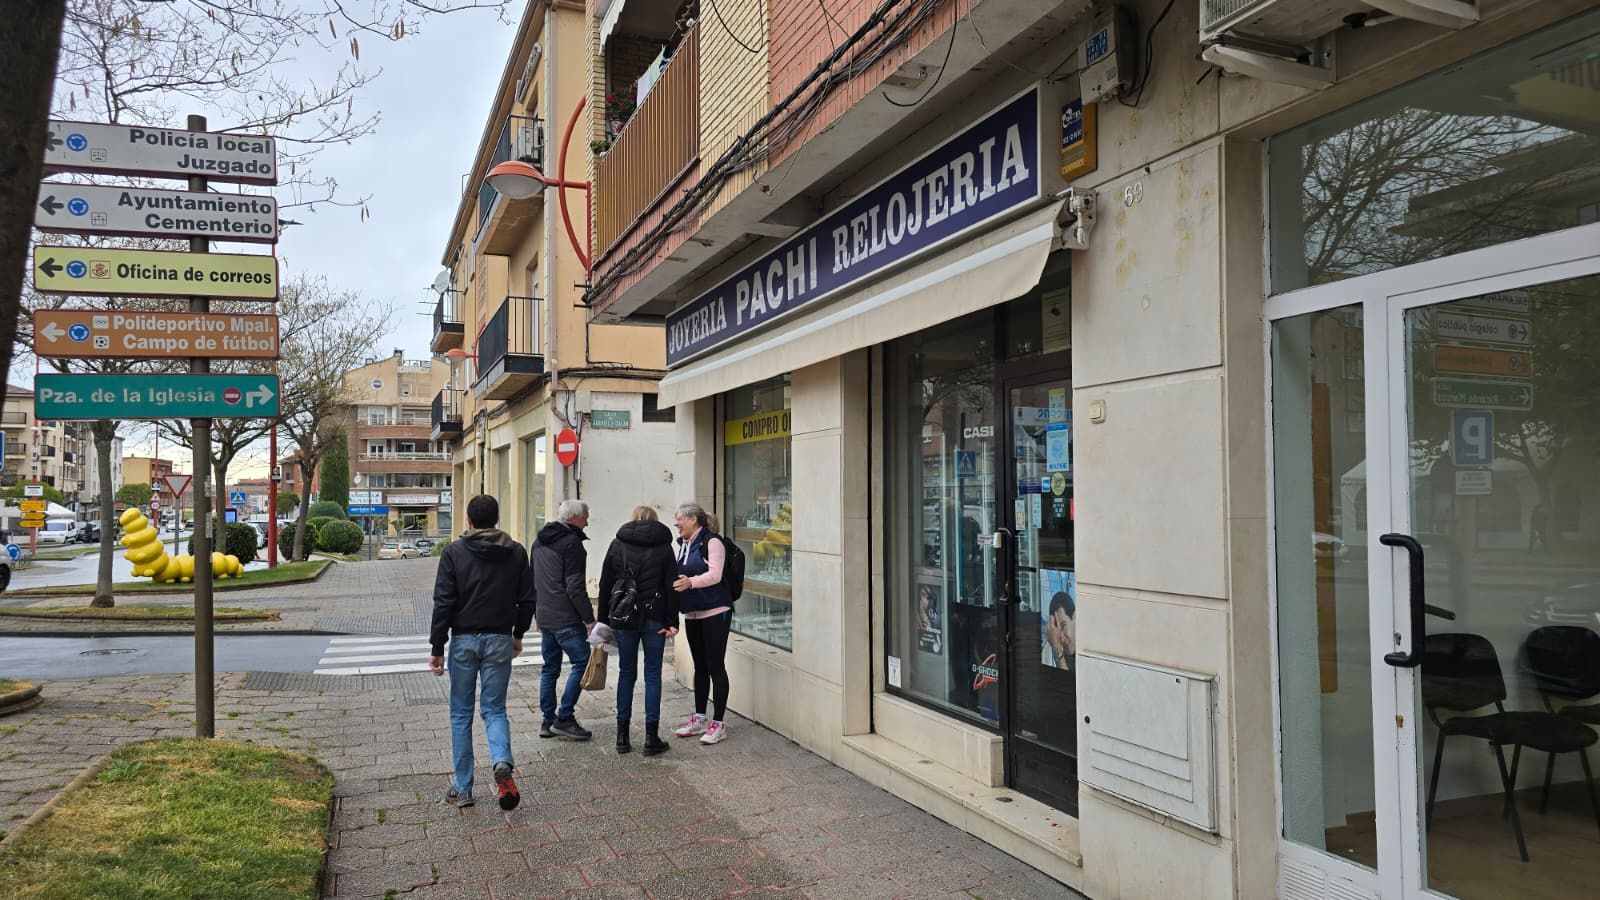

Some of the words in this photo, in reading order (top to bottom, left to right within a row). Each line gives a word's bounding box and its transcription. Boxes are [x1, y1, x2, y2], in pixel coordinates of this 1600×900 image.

[129, 128, 209, 150] Policía
[217, 136, 271, 154] local
[177, 153, 272, 175] Juzgado
[118, 191, 272, 215] Ayuntamiento
[1124, 182, 1144, 207] 69
[144, 213, 273, 235] Cementerio
[669, 296, 727, 355] JOYERIA
[736, 237, 818, 326] PACHI
[832, 123, 1030, 274] RELOJERIA
[116, 263, 178, 281] Oficina
[183, 266, 204, 282] de
[209, 269, 272, 285] correos
[113, 314, 226, 333] Polideportivo
[230, 317, 275, 337] Mpal.
[123, 333, 189, 353] Campo
[195, 335, 217, 350] de
[222, 334, 275, 351] fútbol
[40, 388, 84, 404] Pza.
[91, 388, 115, 404] de
[123, 389, 141, 403] la
[149, 388, 216, 408] Iglesia
[742, 415, 779, 440] COMPRO
